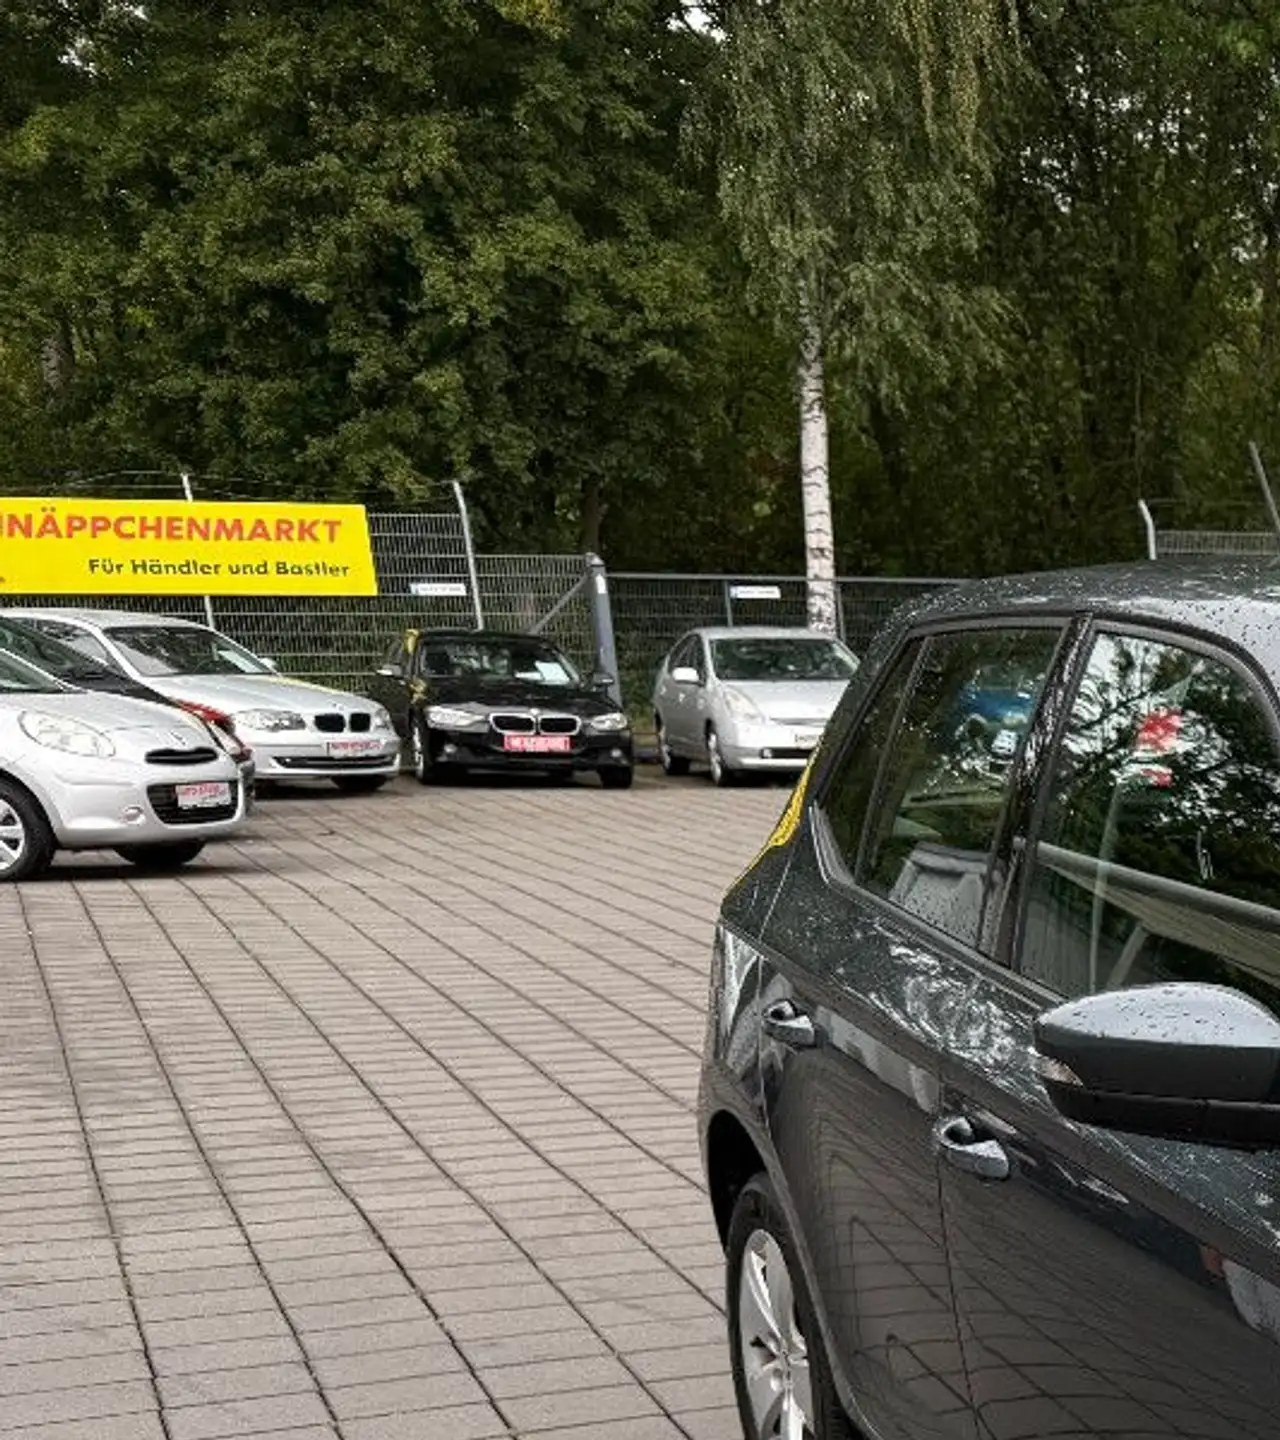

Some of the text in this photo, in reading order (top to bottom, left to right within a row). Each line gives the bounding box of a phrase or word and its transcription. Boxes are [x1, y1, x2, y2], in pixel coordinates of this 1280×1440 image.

[0, 506, 342, 543] NÄPPCHENMARKT
[89, 558, 349, 577] Für Händler und Bastler
